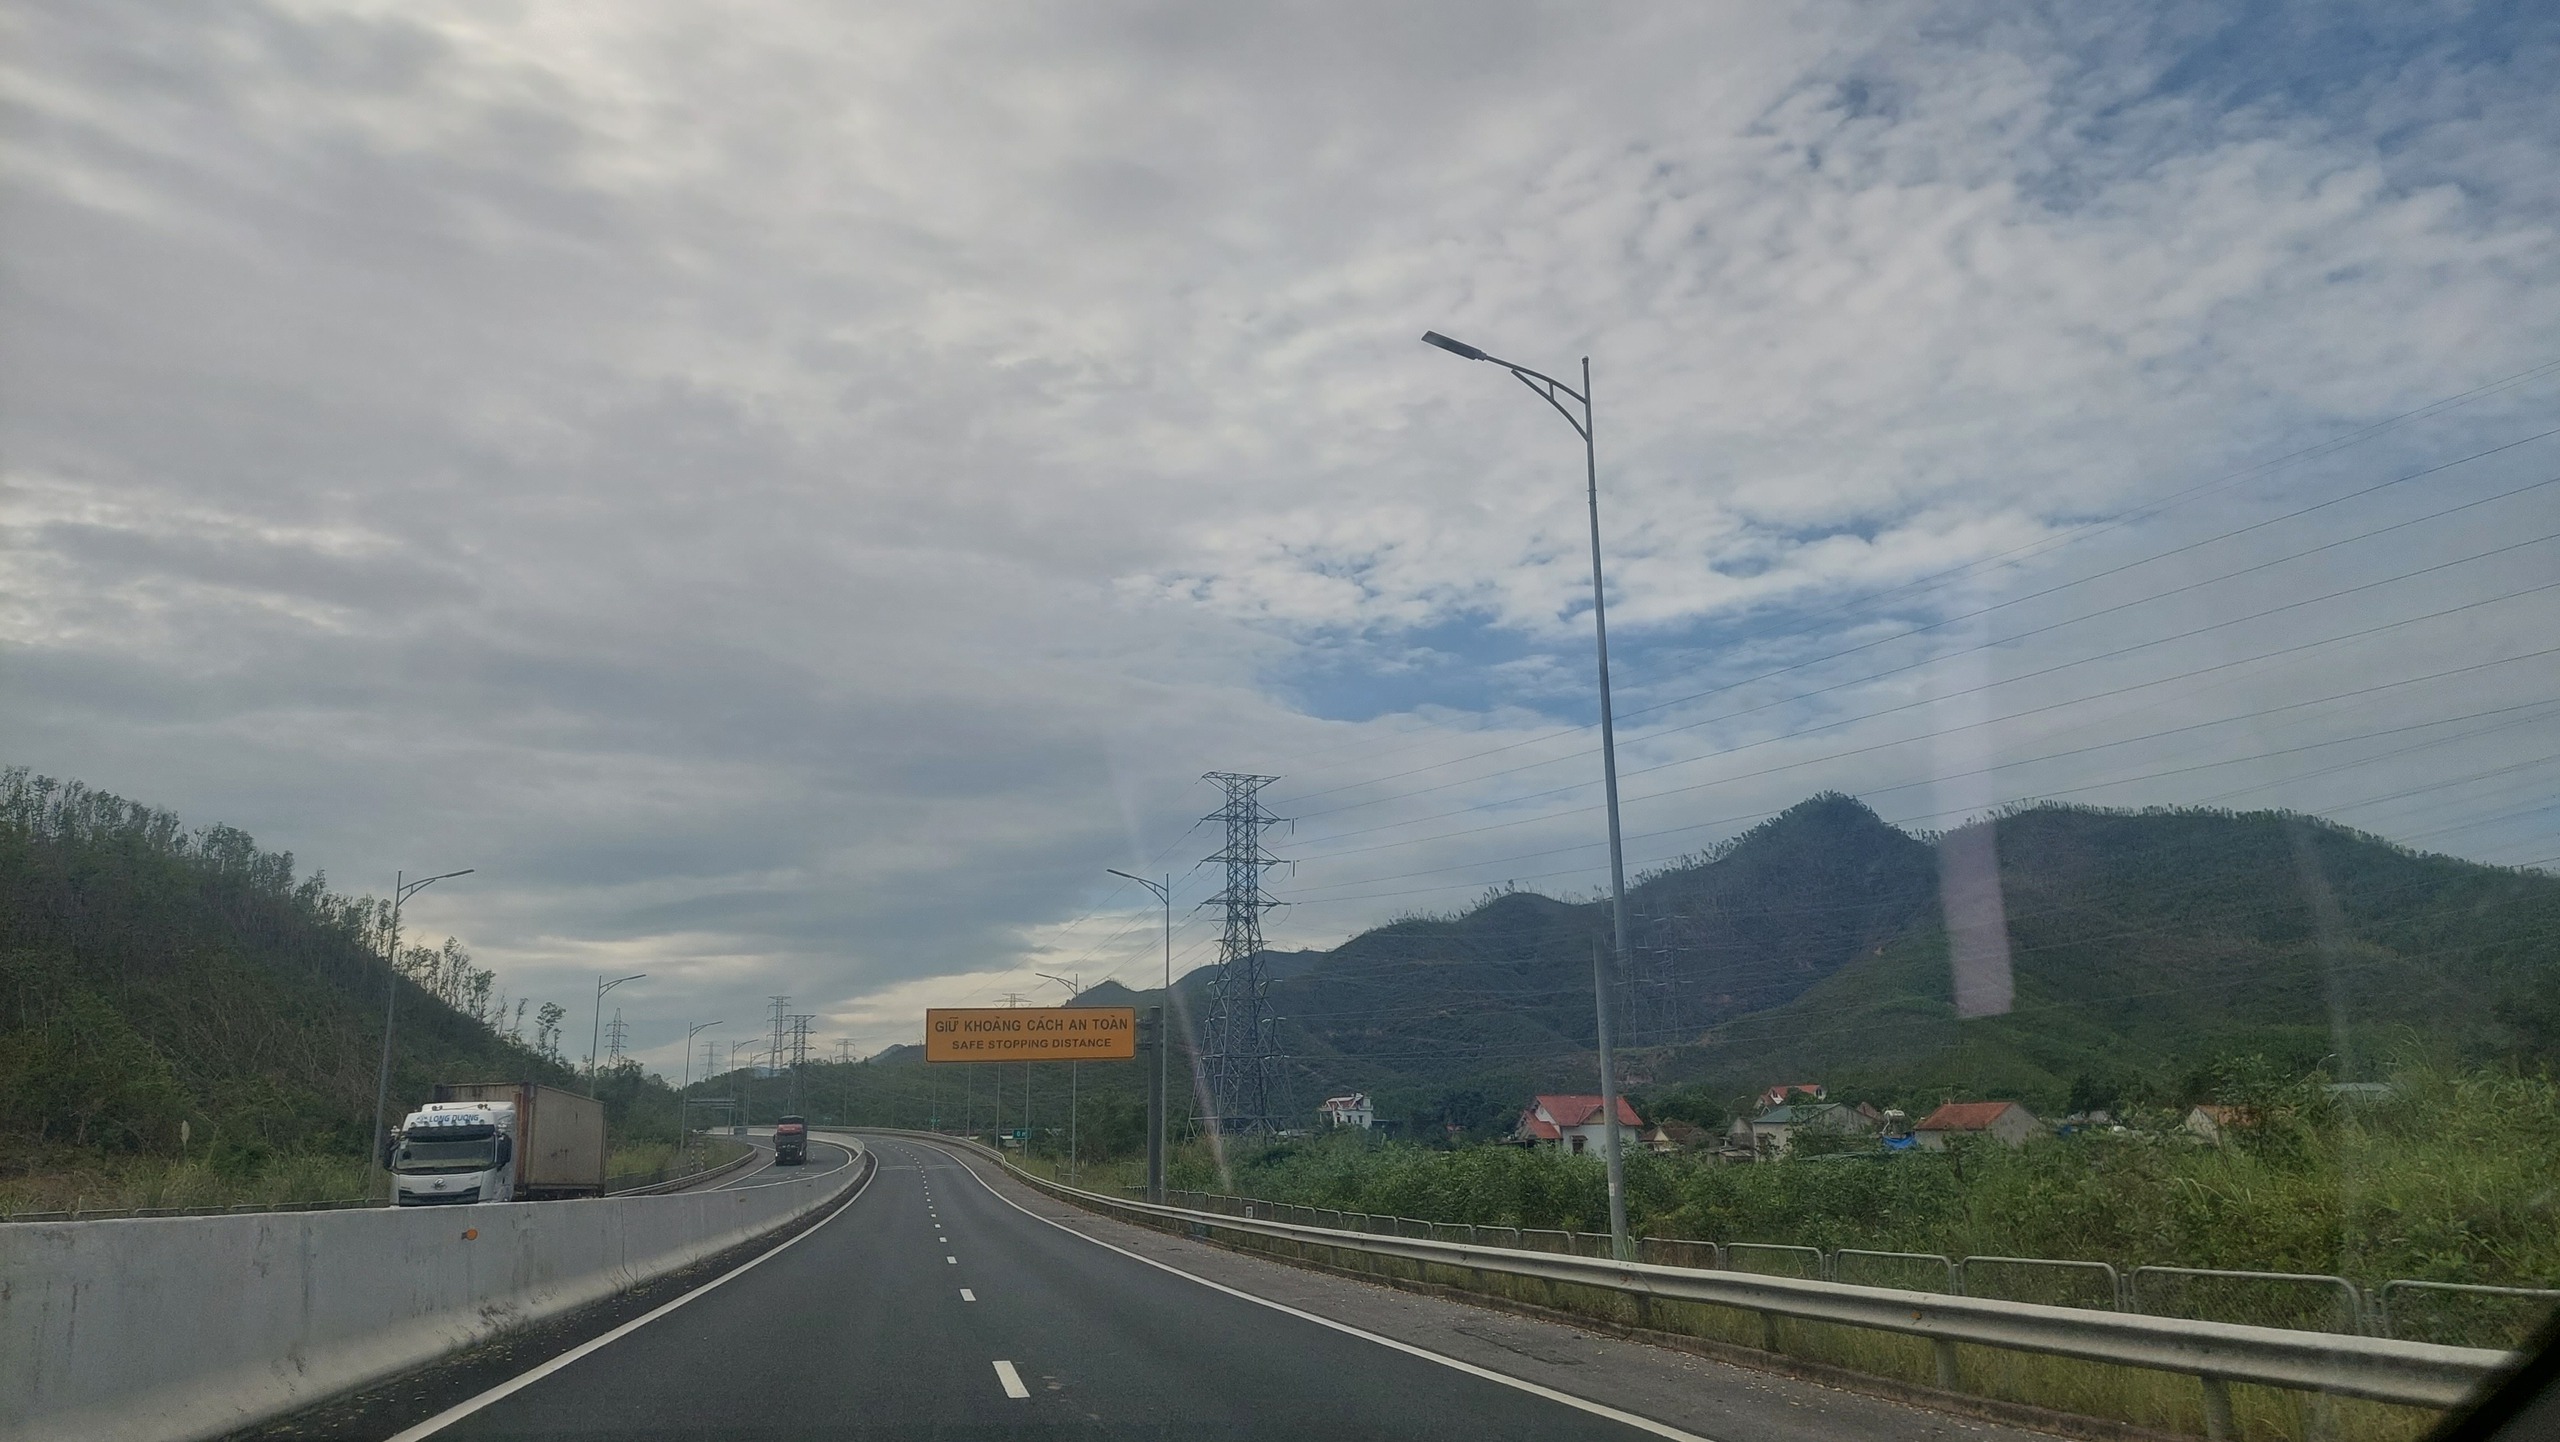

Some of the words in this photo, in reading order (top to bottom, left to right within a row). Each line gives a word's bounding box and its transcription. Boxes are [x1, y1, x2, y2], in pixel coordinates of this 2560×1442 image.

[935, 1016, 959, 1032] GIỮ
[964, 1016, 1021, 1032] KHOẢNG
[1027, 1015, 1064, 1031] CÁCH
[1068, 1019, 1087, 1031] AN
[1092, 1014, 1128, 1030] TOÀN
[952, 1040, 984, 1050] SAFE
[988, 1039, 1049, 1049] STOPPING
[1052, 1038, 1112, 1048] DISTANCE
[429, 1114, 450, 1123] LONG
